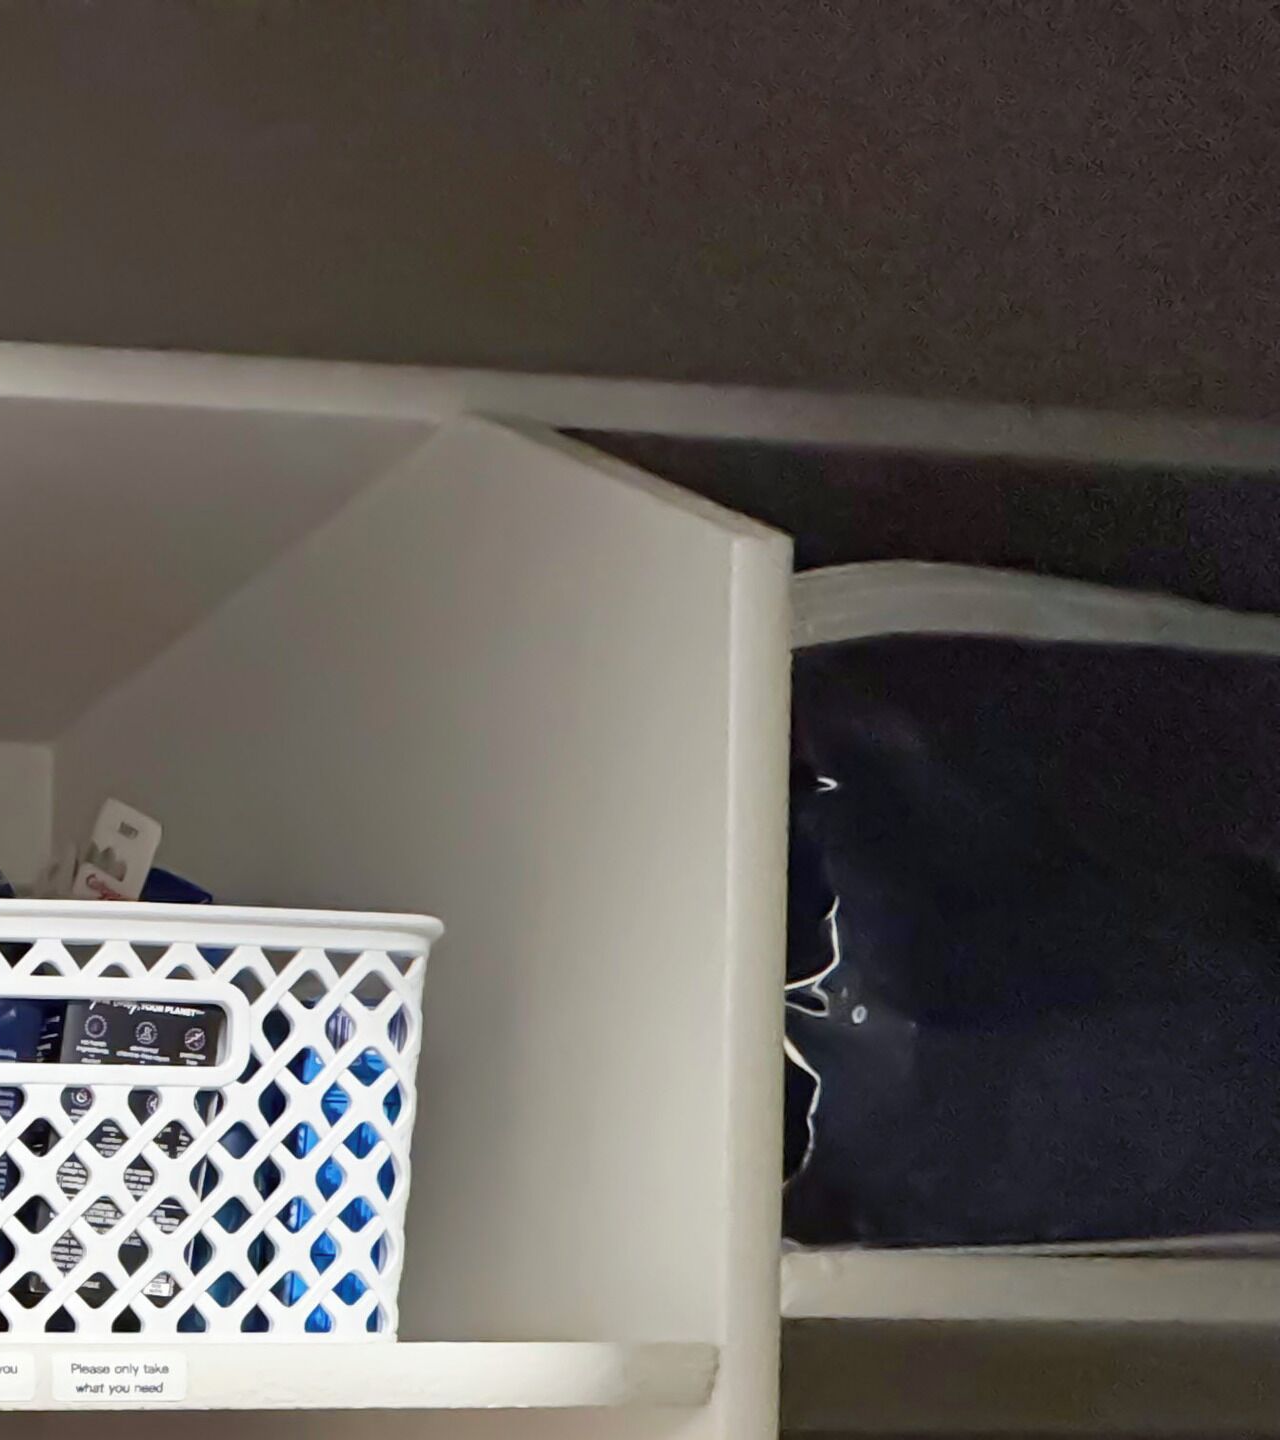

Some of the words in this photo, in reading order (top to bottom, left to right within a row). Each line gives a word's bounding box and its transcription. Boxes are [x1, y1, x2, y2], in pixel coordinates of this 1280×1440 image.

[71, 1363, 110, 1375] Please
[114, 1363, 139, 1378] only
[143, 1363, 169, 1375] take
[75, 1382, 104, 1394] what
[108, 1384, 130, 1396] you
[134, 1382, 164, 1394] need
